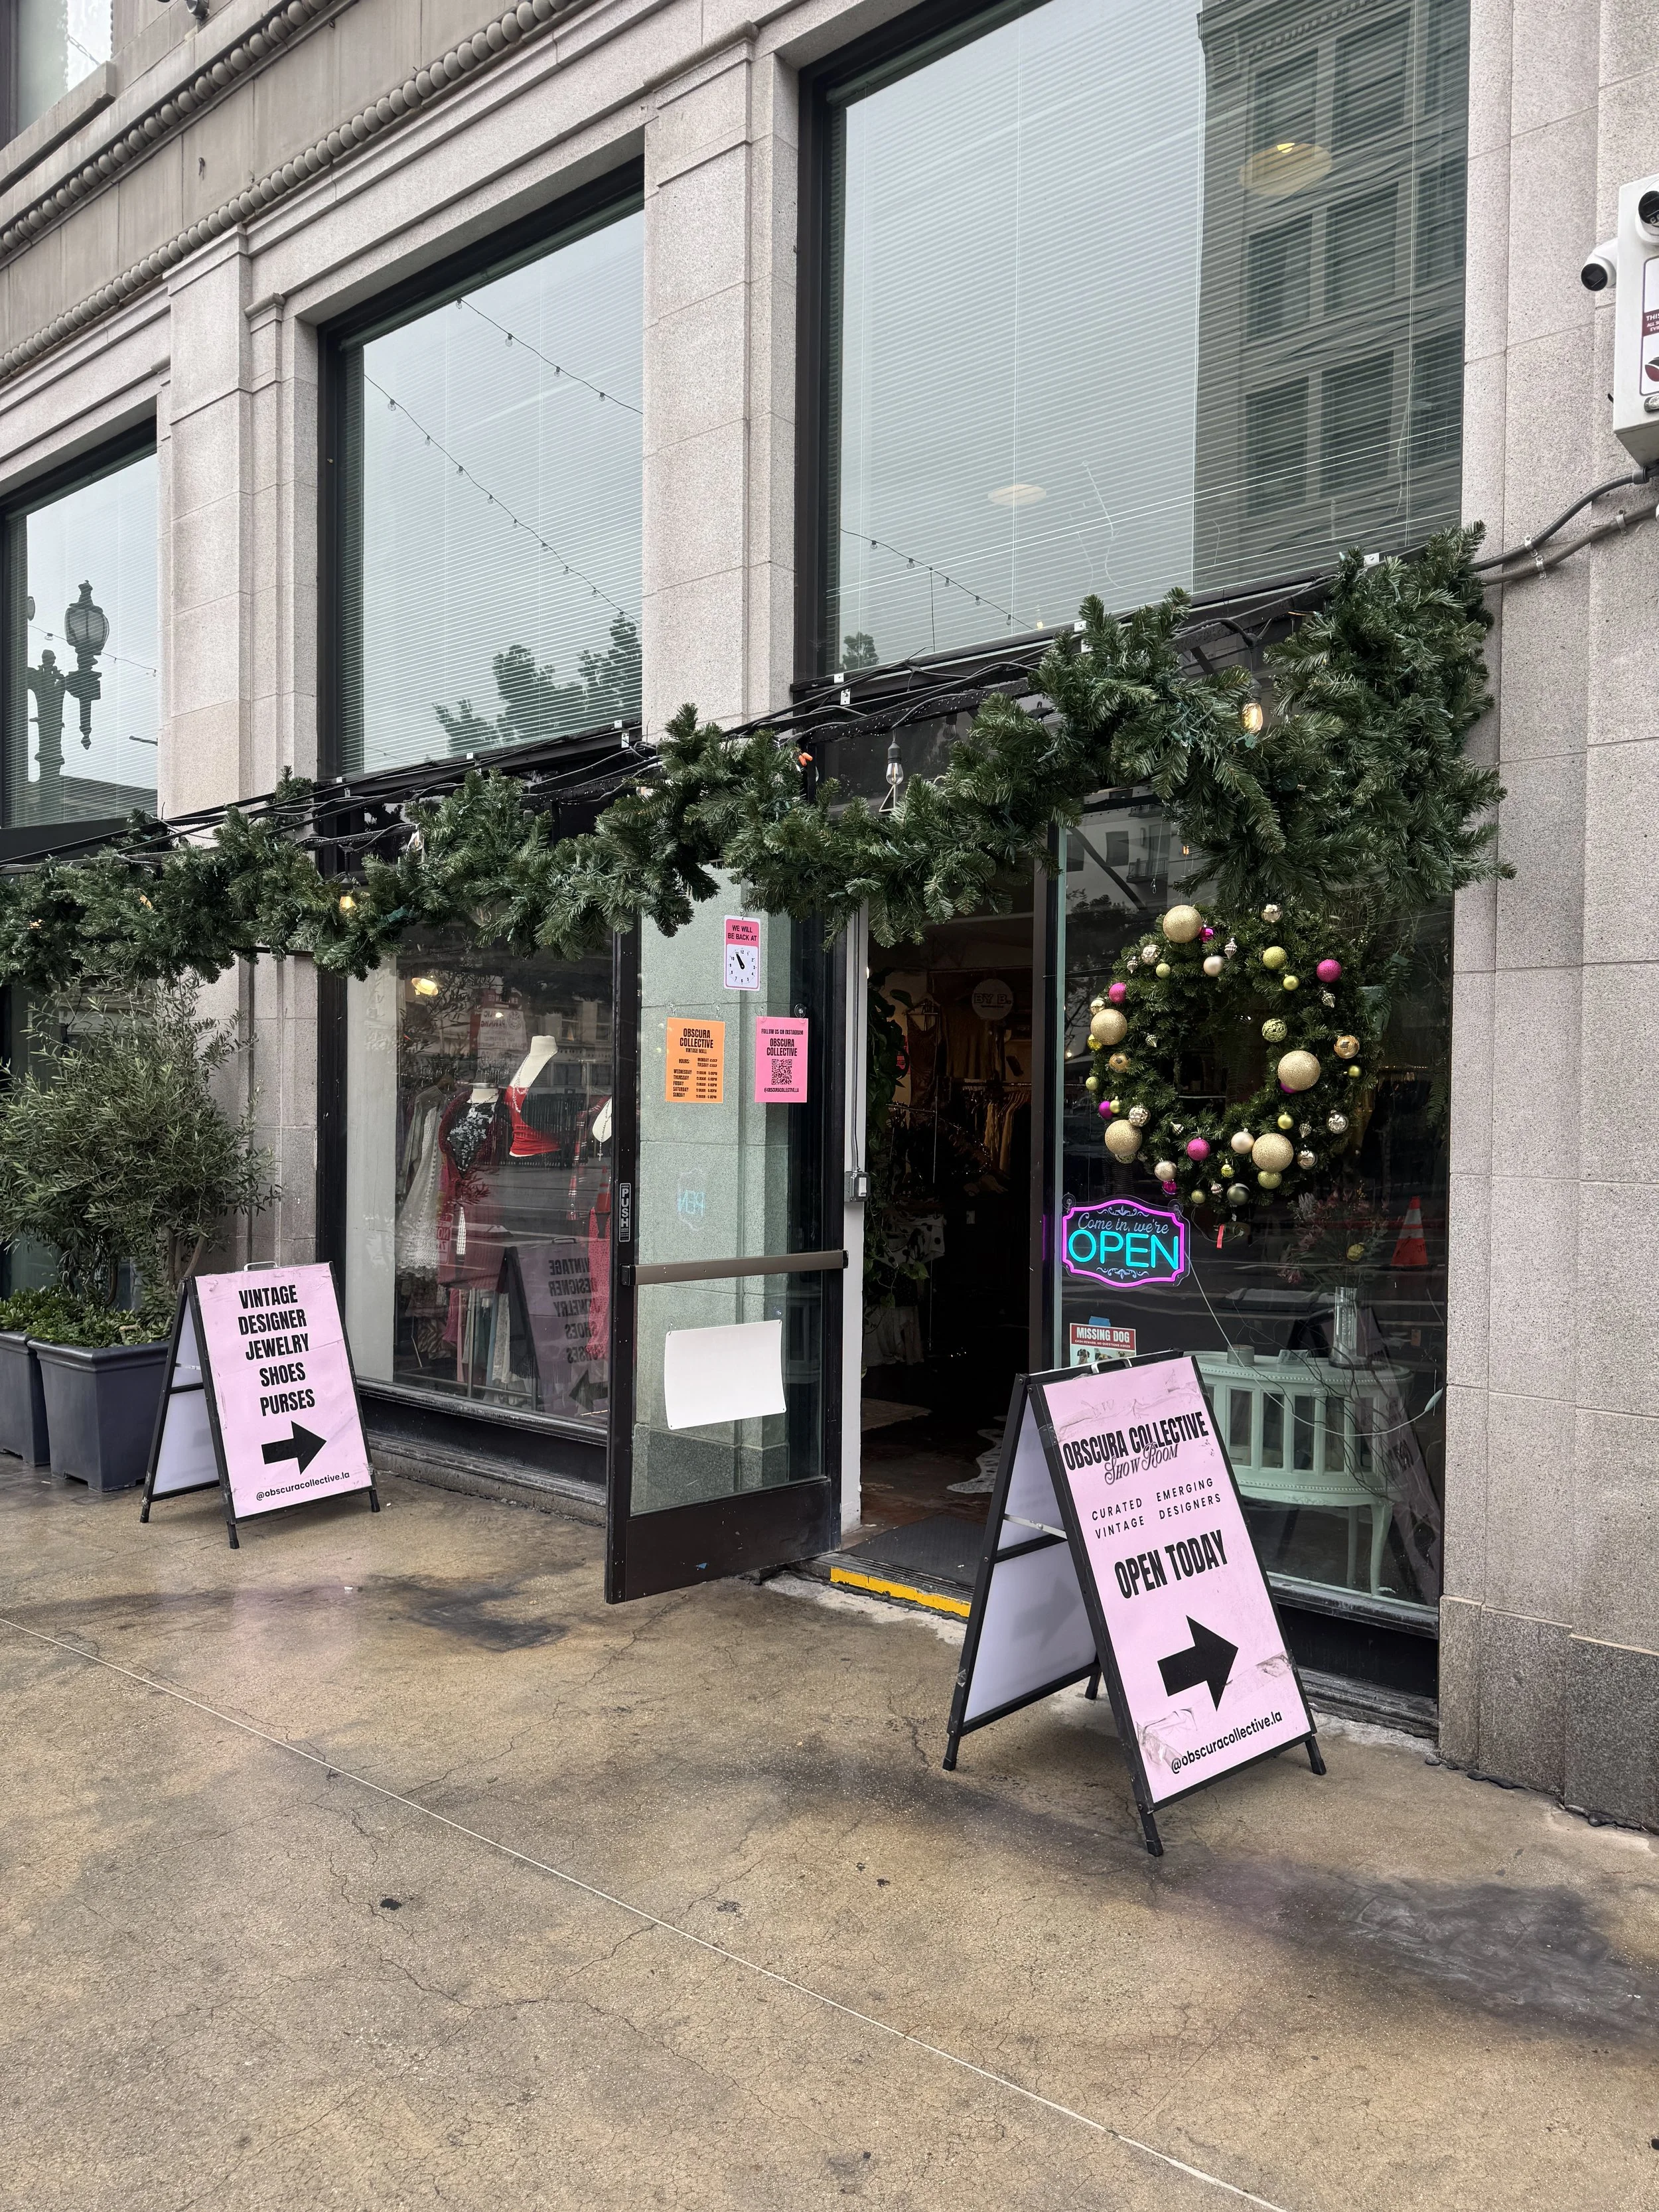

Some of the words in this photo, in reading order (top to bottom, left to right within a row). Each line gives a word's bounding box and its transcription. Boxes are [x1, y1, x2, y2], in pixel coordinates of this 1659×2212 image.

[680, 1037, 714, 1049] COLLECTIVE
[683, 1028, 711, 1039] OBSCURA
[770, 1038, 794, 1047] OBSCURA
[766, 1047, 798, 1057] COLLECTIVE
[620, 1187, 629, 1228] PUSH
[1078, 1212, 1113, 1230] Come
[1133, 1217, 1169, 1234] we're
[1068, 1229, 1179, 1270] OPEN
[238, 1284, 299, 1309] VINTAGE
[238, 1308, 307, 1335] DESIGNER
[1076, 1327, 1111, 1341] MISSING
[1113, 1330, 1130, 1343] DOG
[245, 1333, 310, 1361] JEWELRY
[259, 1362, 306, 1387] SHOES
[259, 1388, 316, 1417] PURSES
[1062, 1430, 1129, 1471] OBSCURA
[1128, 1411, 1209, 1453] COLLECTIVE
[255, 1471, 350, 1501] @obscuracollective.la
[1092, 1497, 1143, 1521] CURATED
[1156, 1477, 1214, 1503] EMERGING
[1095, 1516, 1145, 1540] VINTAGE
[1159, 1493, 1222, 1520] DESIGNERS
[1114, 1549, 1167, 1599] OPEN
[1165, 1528, 1228, 1581] TODAY
[1171, 1710, 1283, 1774] @obscuracollective.la
